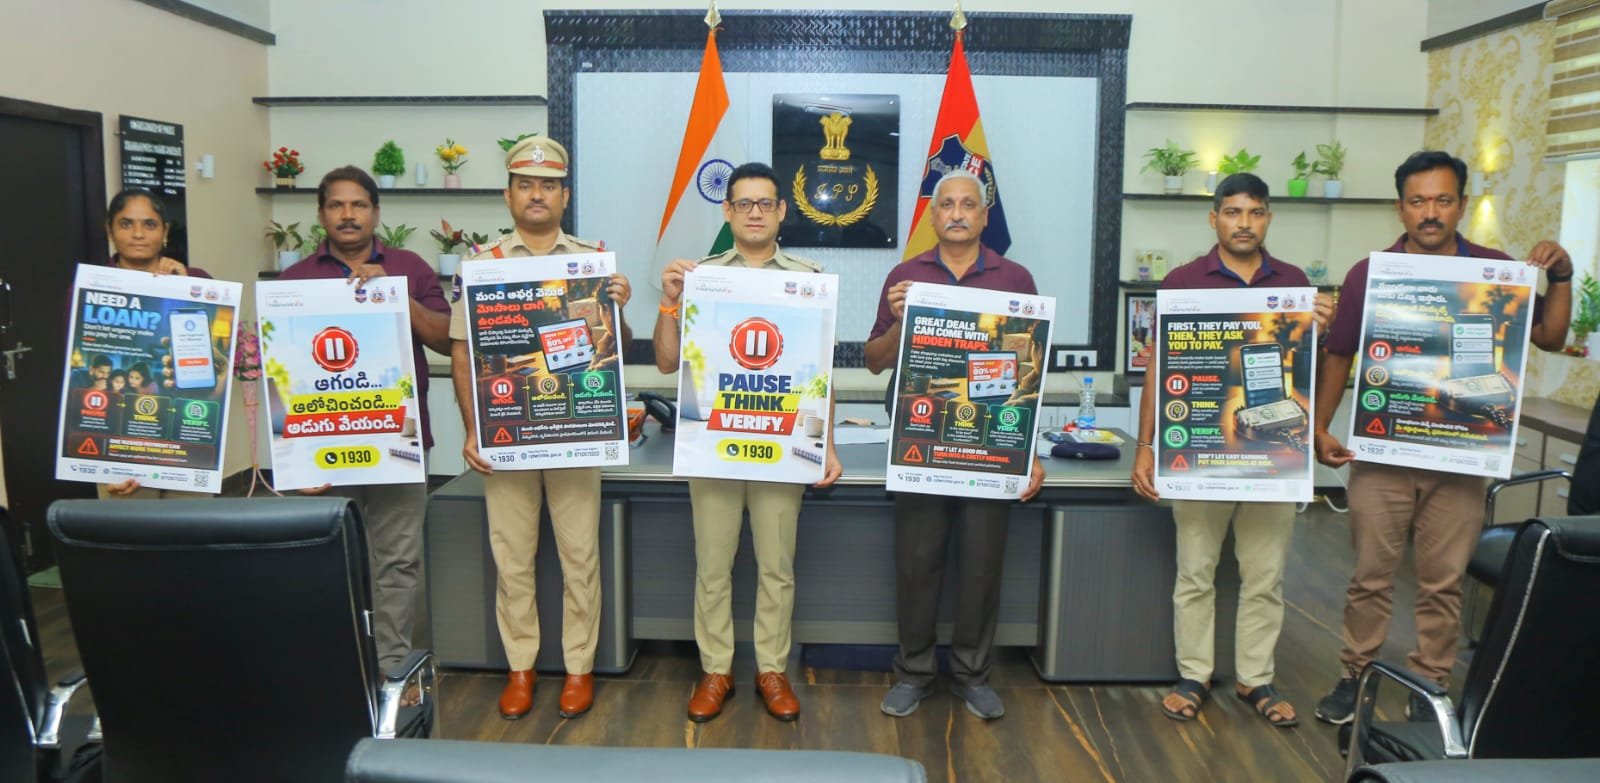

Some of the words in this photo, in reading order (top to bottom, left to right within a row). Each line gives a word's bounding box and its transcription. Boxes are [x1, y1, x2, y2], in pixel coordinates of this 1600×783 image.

[86, 291, 128, 307] NEED
[129, 296, 141, 309] A
[476, 291, 505, 302] మంచి
[84, 304, 162, 330] LOAN?
[914, 316, 946, 327] GREAT
[946, 320, 976, 330] DEALS
[914, 326, 934, 336] CAN
[936, 328, 964, 338] COME
[964, 332, 988, 342] WITH
[1168, 322, 1196, 332] FIRST,
[1197, 322, 1222, 330] THEY
[1223, 322, 1242, 330] PAY
[1242, 321, 1262, 330] YOU.
[912, 334, 952, 348] HIDDEN
[954, 338, 990, 352] TRAPS.
[1168, 332, 1196, 342] THEN,
[1198, 332, 1222, 340] THEY
[1224, 331, 1244, 340] ASK
[1168, 342, 1188, 350] YOU
[1190, 341, 1202, 350] TO
[1203, 341, 1224, 350] PAY.
[314, 372, 382, 391] ఆగండి...
[719, 373, 802, 394] PAUSE...
[293, 394, 398, 414] ఆలోచించండి...
[722, 393, 795, 412] THINK...
[287, 418, 335, 434] అడుగు
[338, 414, 400, 431] వేయండి.
[720, 413, 784, 432] VERIFY.
[340, 450, 372, 464] 1930
[498, 454, 514, 462] 1930
[742, 444, 773, 459] 1930
